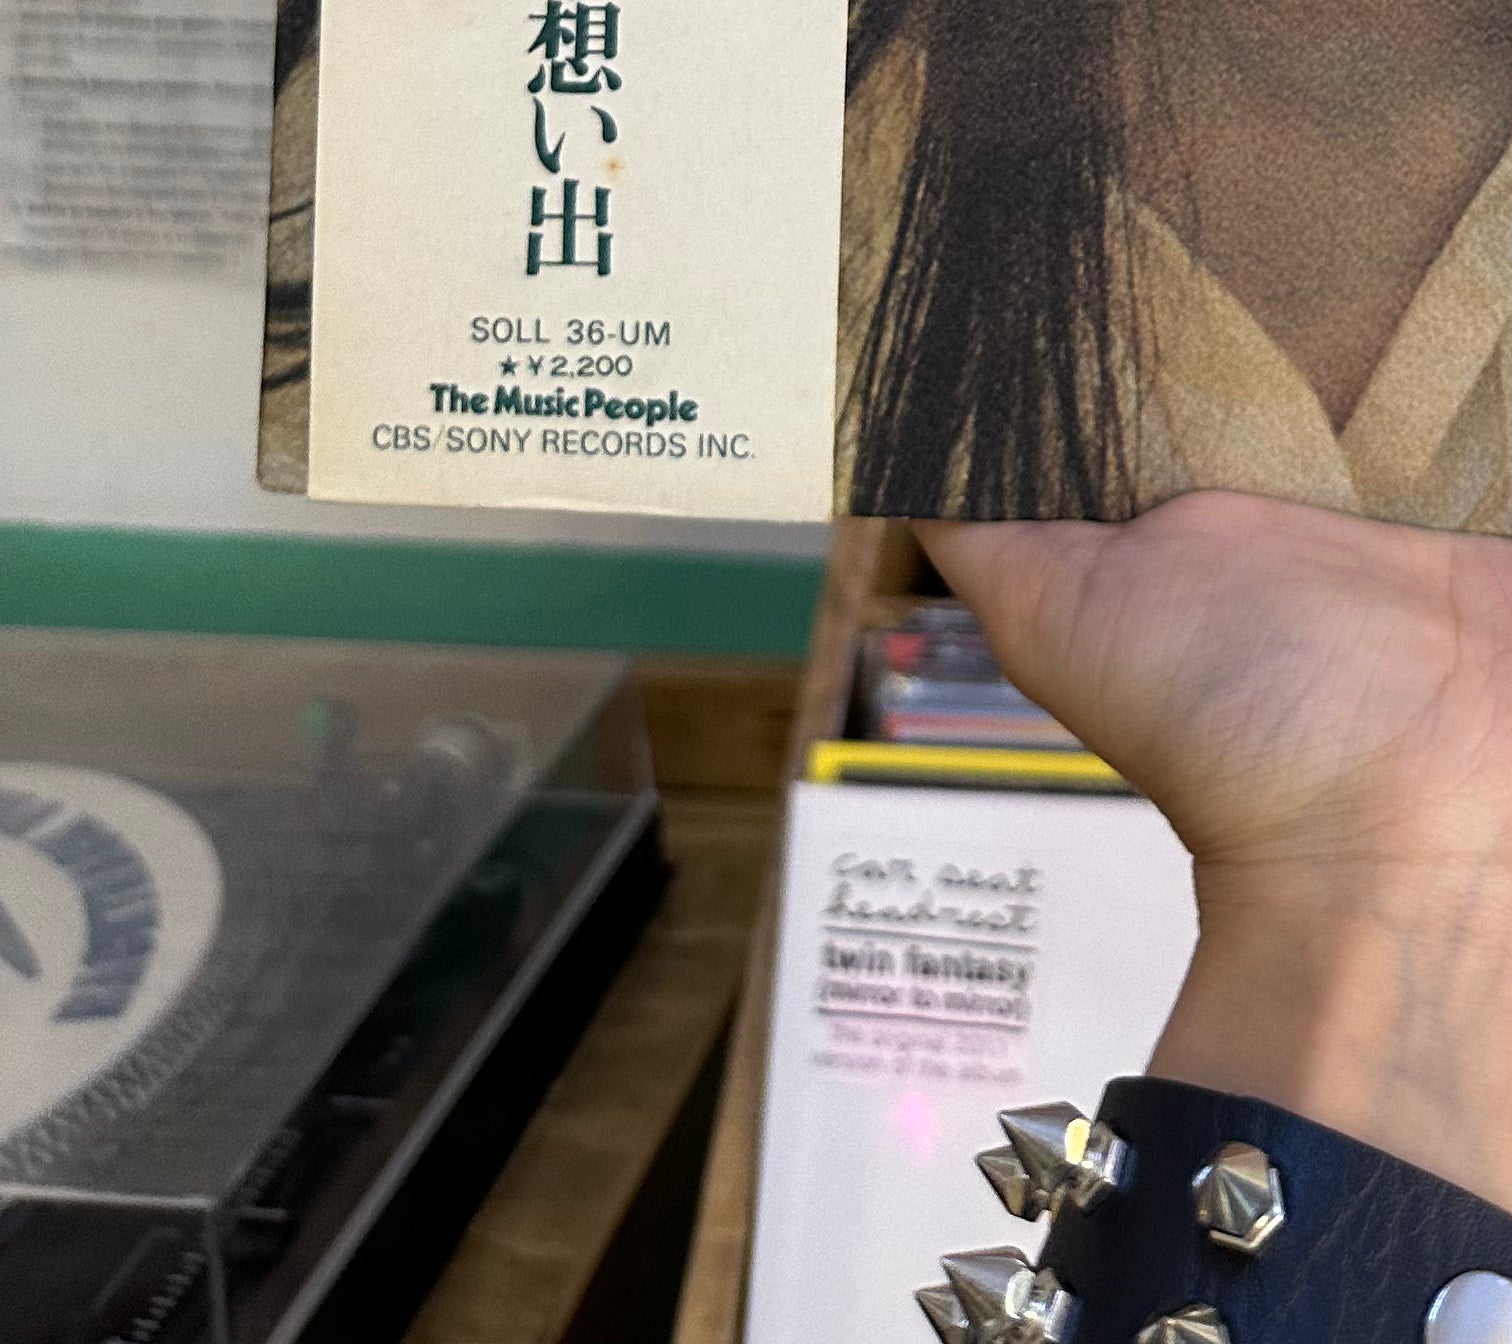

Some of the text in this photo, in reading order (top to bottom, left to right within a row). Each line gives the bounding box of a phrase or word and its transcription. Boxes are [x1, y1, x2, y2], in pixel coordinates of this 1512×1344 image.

[469, 315, 672, 347] SOLL 36-UM
[429, 382, 700, 429] The Music People
[371, 423, 757, 461] CBS/SONY RECORDS INC.
[821, 939, 1034, 993] twin fantasy
